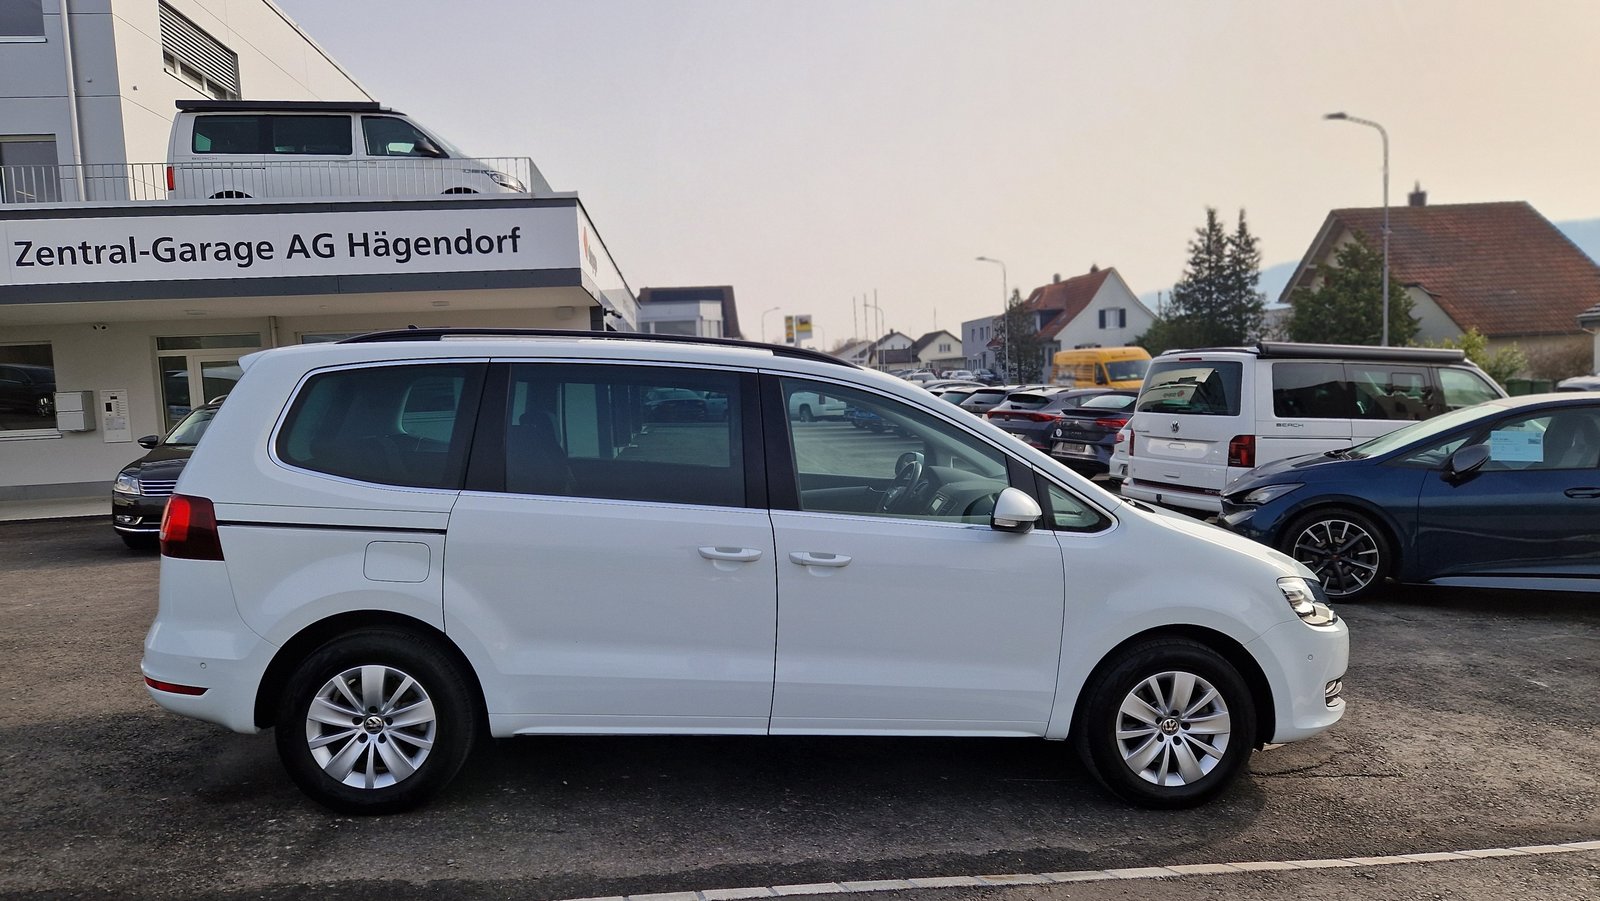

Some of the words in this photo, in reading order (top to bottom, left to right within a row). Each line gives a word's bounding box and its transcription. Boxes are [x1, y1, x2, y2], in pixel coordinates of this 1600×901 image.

[14, 236, 275, 268] Zentral-Garage
[286, 232, 336, 260] AG
[347, 226, 521, 264] Hägendorf
